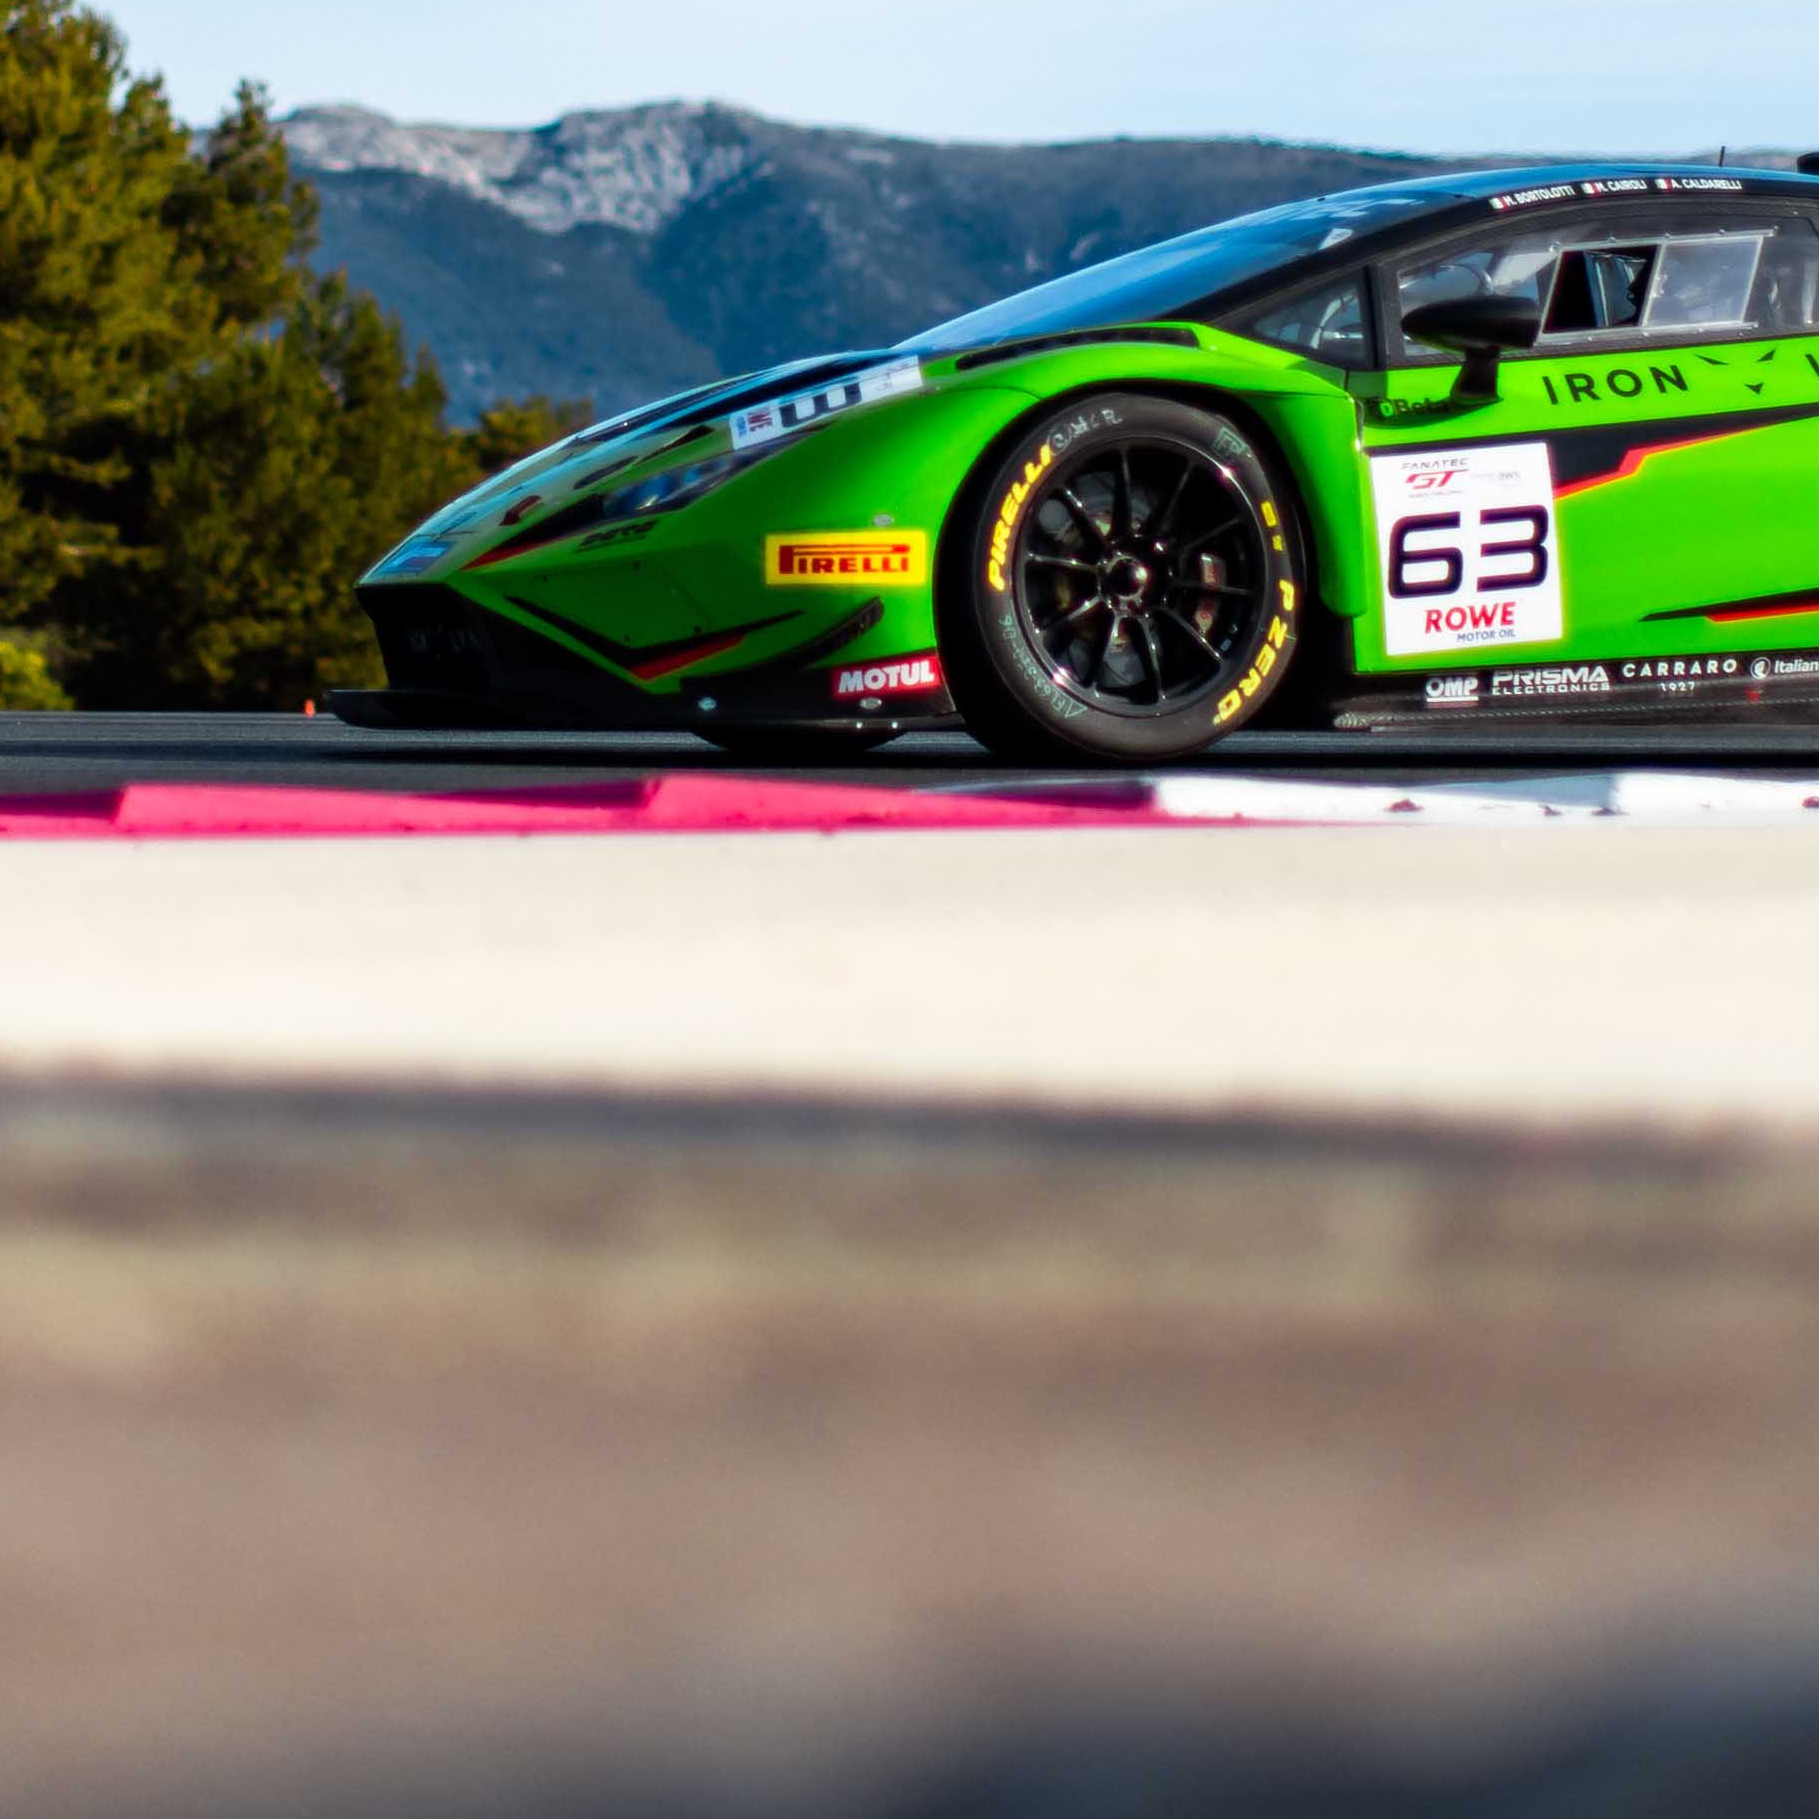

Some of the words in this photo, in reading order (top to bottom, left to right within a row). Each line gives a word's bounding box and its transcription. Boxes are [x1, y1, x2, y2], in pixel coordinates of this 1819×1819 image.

[1609, 180, 1648, 192] CAIROLI
[1682, 178, 1743, 190] CALDARELLI
[1517, 185, 1576, 205] BORTOLOTTI
[1541, 364, 1690, 406] IRON
[1401, 457, 1470, 470] FANATEC
[1405, 469, 1469, 489] GT
[987, 442, 1052, 592] PIRELLI
[779, 544, 910, 574] PIRELLI
[1388, 504, 1549, 599] 63
[1424, 602, 1516, 634] ROWE
[1456, 630, 1496, 643] MOTOR
[1498, 628, 1516, 638] OIL
[838, 659, 935, 694] MOTUL
[1492, 665, 1610, 686] PRISMA
[1622, 658, 1738, 678] CARRARO
[1426, 676, 1479, 697] OMP
[1492, 682, 1611, 696] ELECTRONICS
[1659, 681, 1696, 692] 1927
